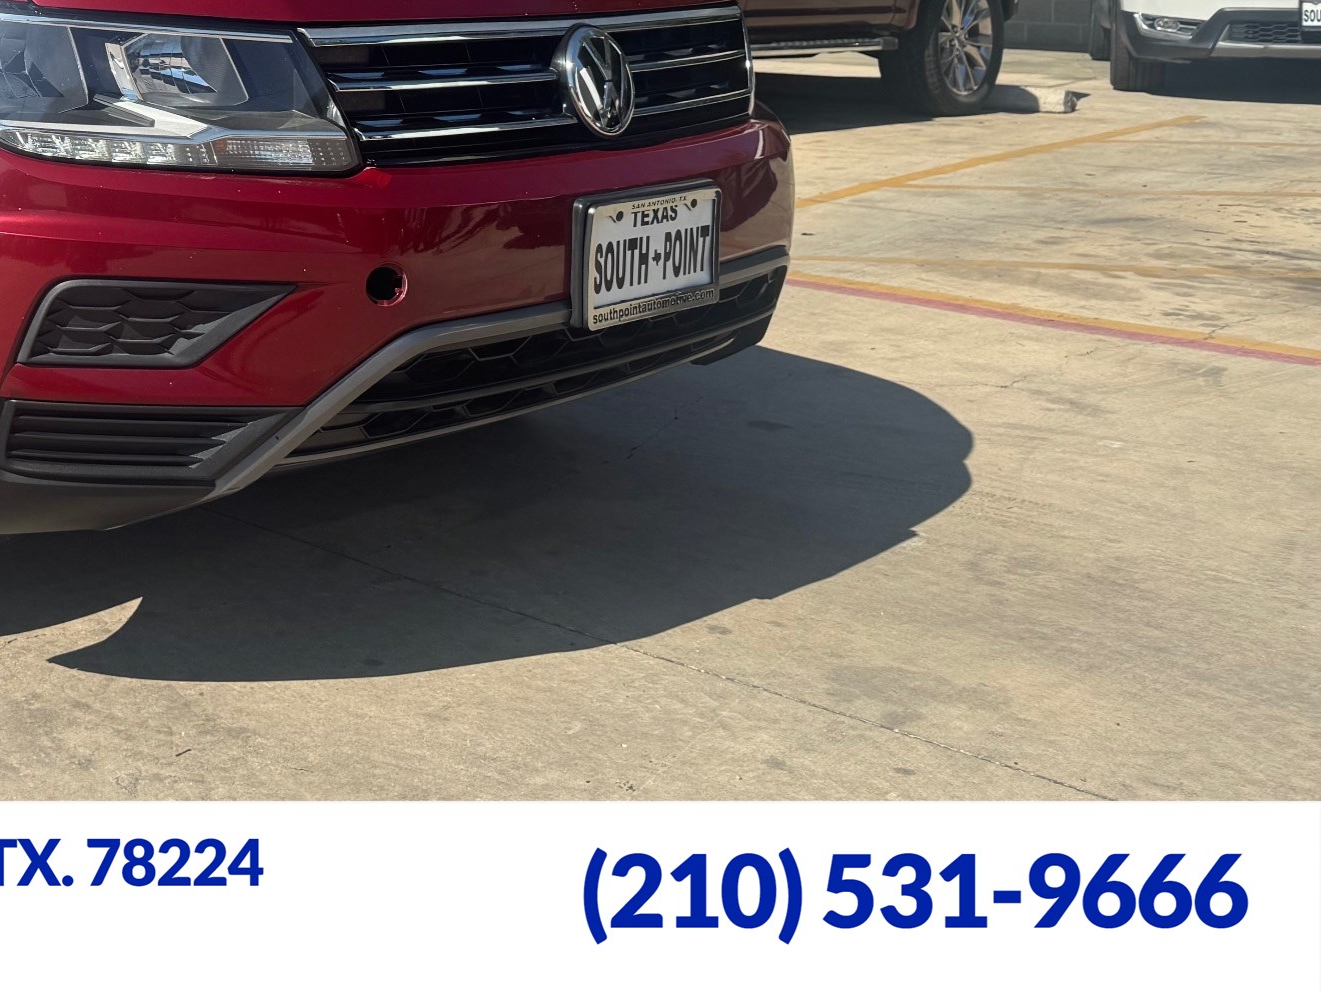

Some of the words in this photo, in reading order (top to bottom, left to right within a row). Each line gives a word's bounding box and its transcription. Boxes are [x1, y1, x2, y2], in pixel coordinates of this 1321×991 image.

[631, 205, 678, 227] TEXAS
[594, 235, 650, 295] SOUTH
[662, 224, 711, 280] POINT
[592, 287, 715, 325] southpointautomotive.com
